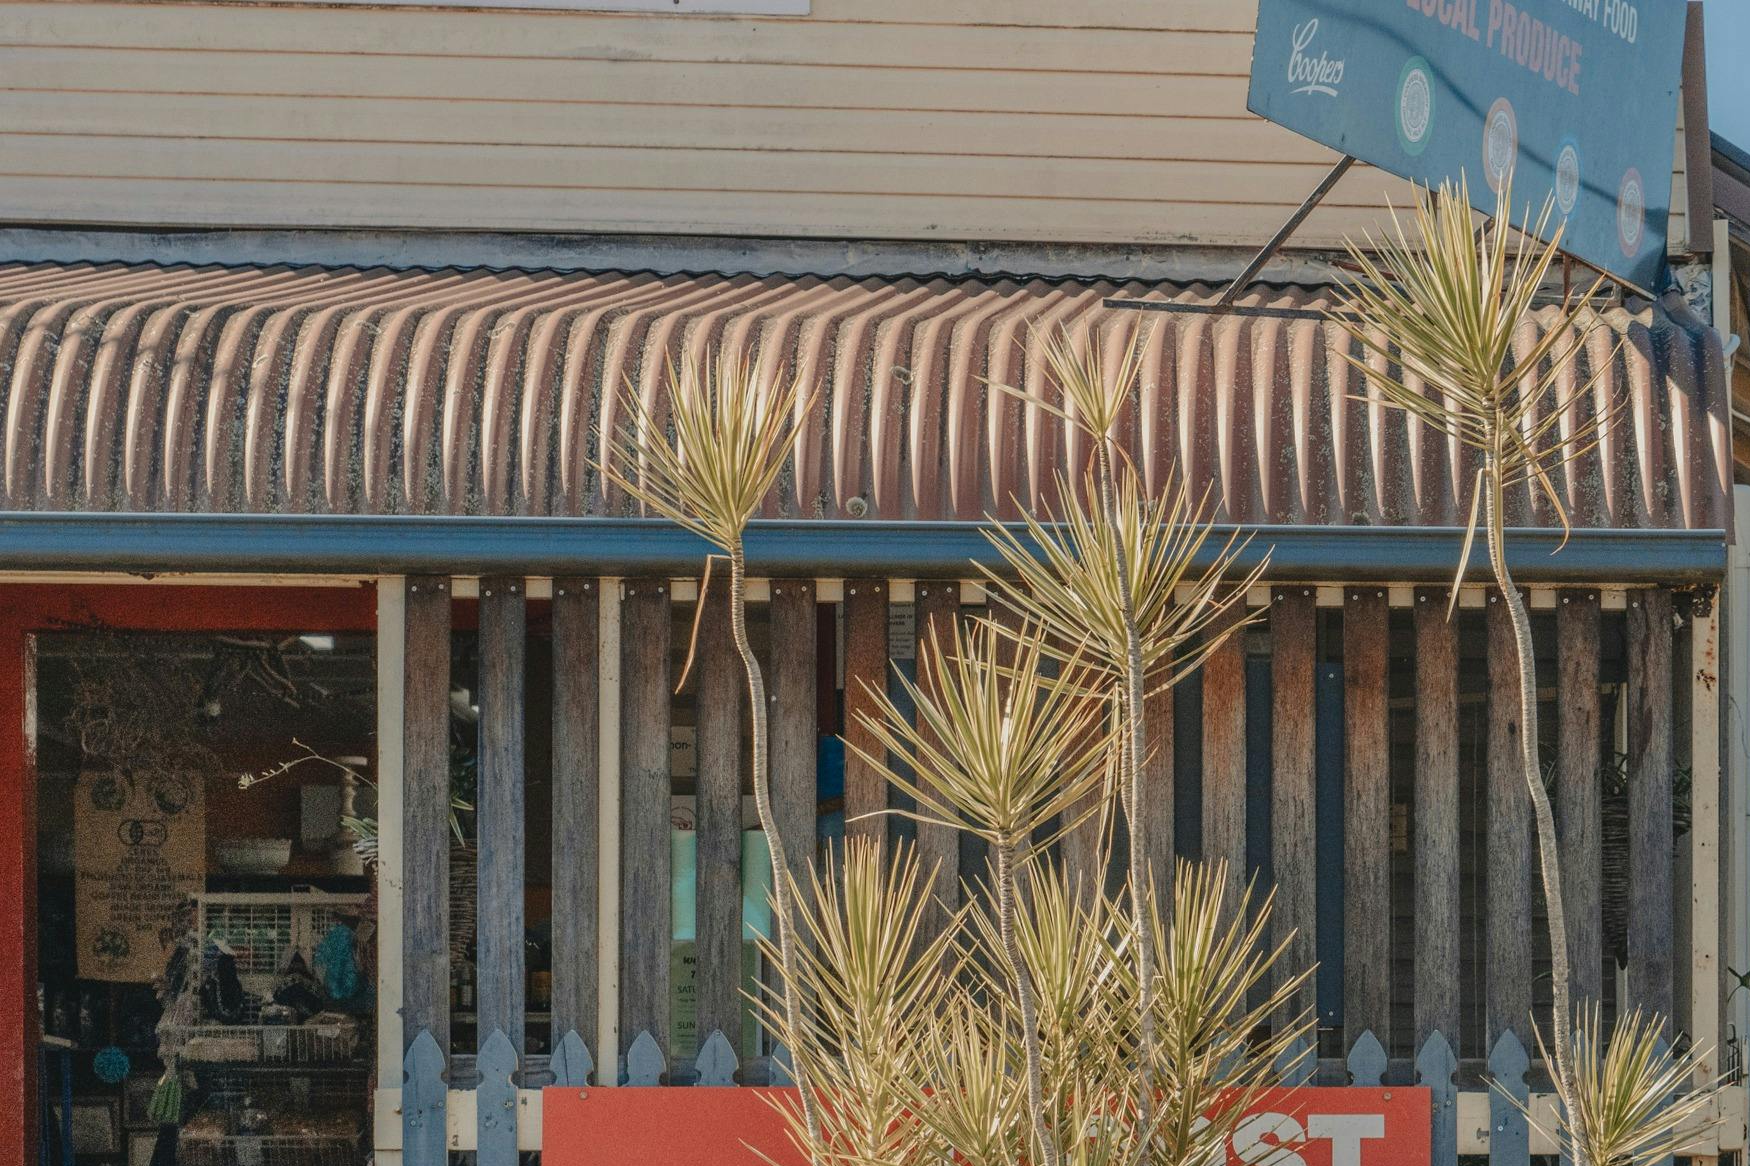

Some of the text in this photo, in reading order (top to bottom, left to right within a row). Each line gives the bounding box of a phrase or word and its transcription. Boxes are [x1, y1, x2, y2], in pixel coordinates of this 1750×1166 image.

[1288, 18, 1344, 96] Coopers
[1486, 0, 1583, 96] PRODUCE
[1603, 0, 1638, 43] FOOD
